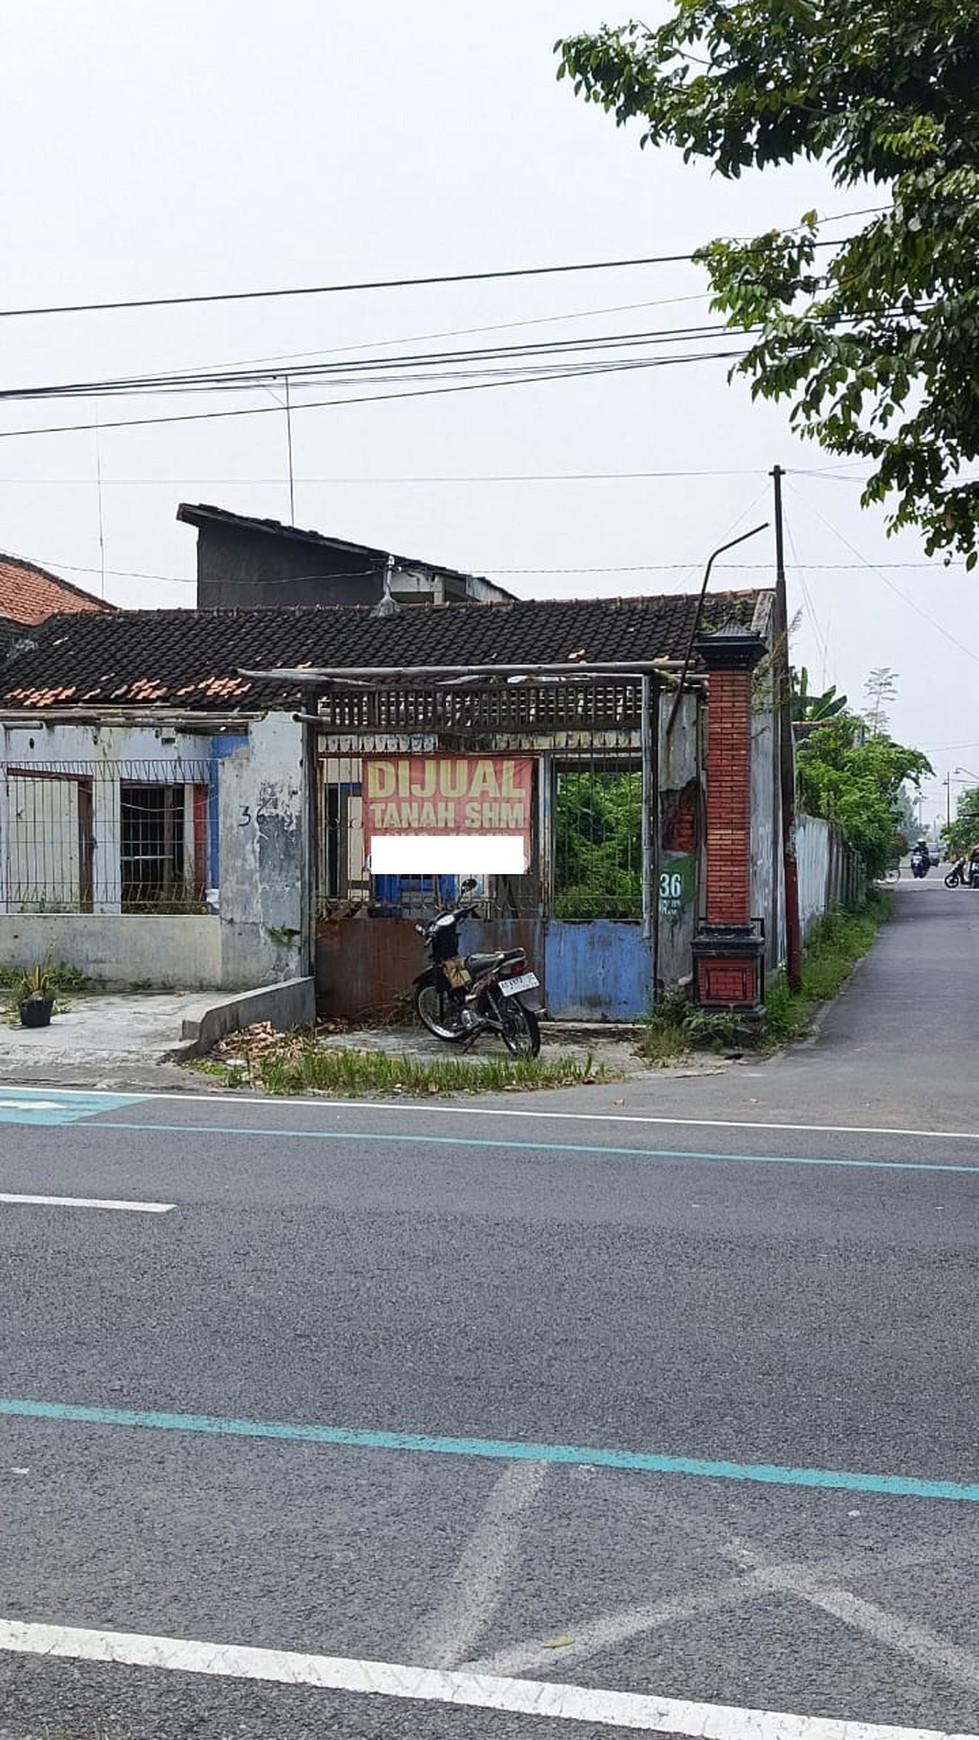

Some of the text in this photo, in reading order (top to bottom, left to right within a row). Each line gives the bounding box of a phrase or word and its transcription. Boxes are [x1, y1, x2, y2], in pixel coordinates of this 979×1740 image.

[367, 759, 526, 798] DIJUAL
[370, 802, 524, 828] TANAH SHM
[660, 873, 681, 898] 36
